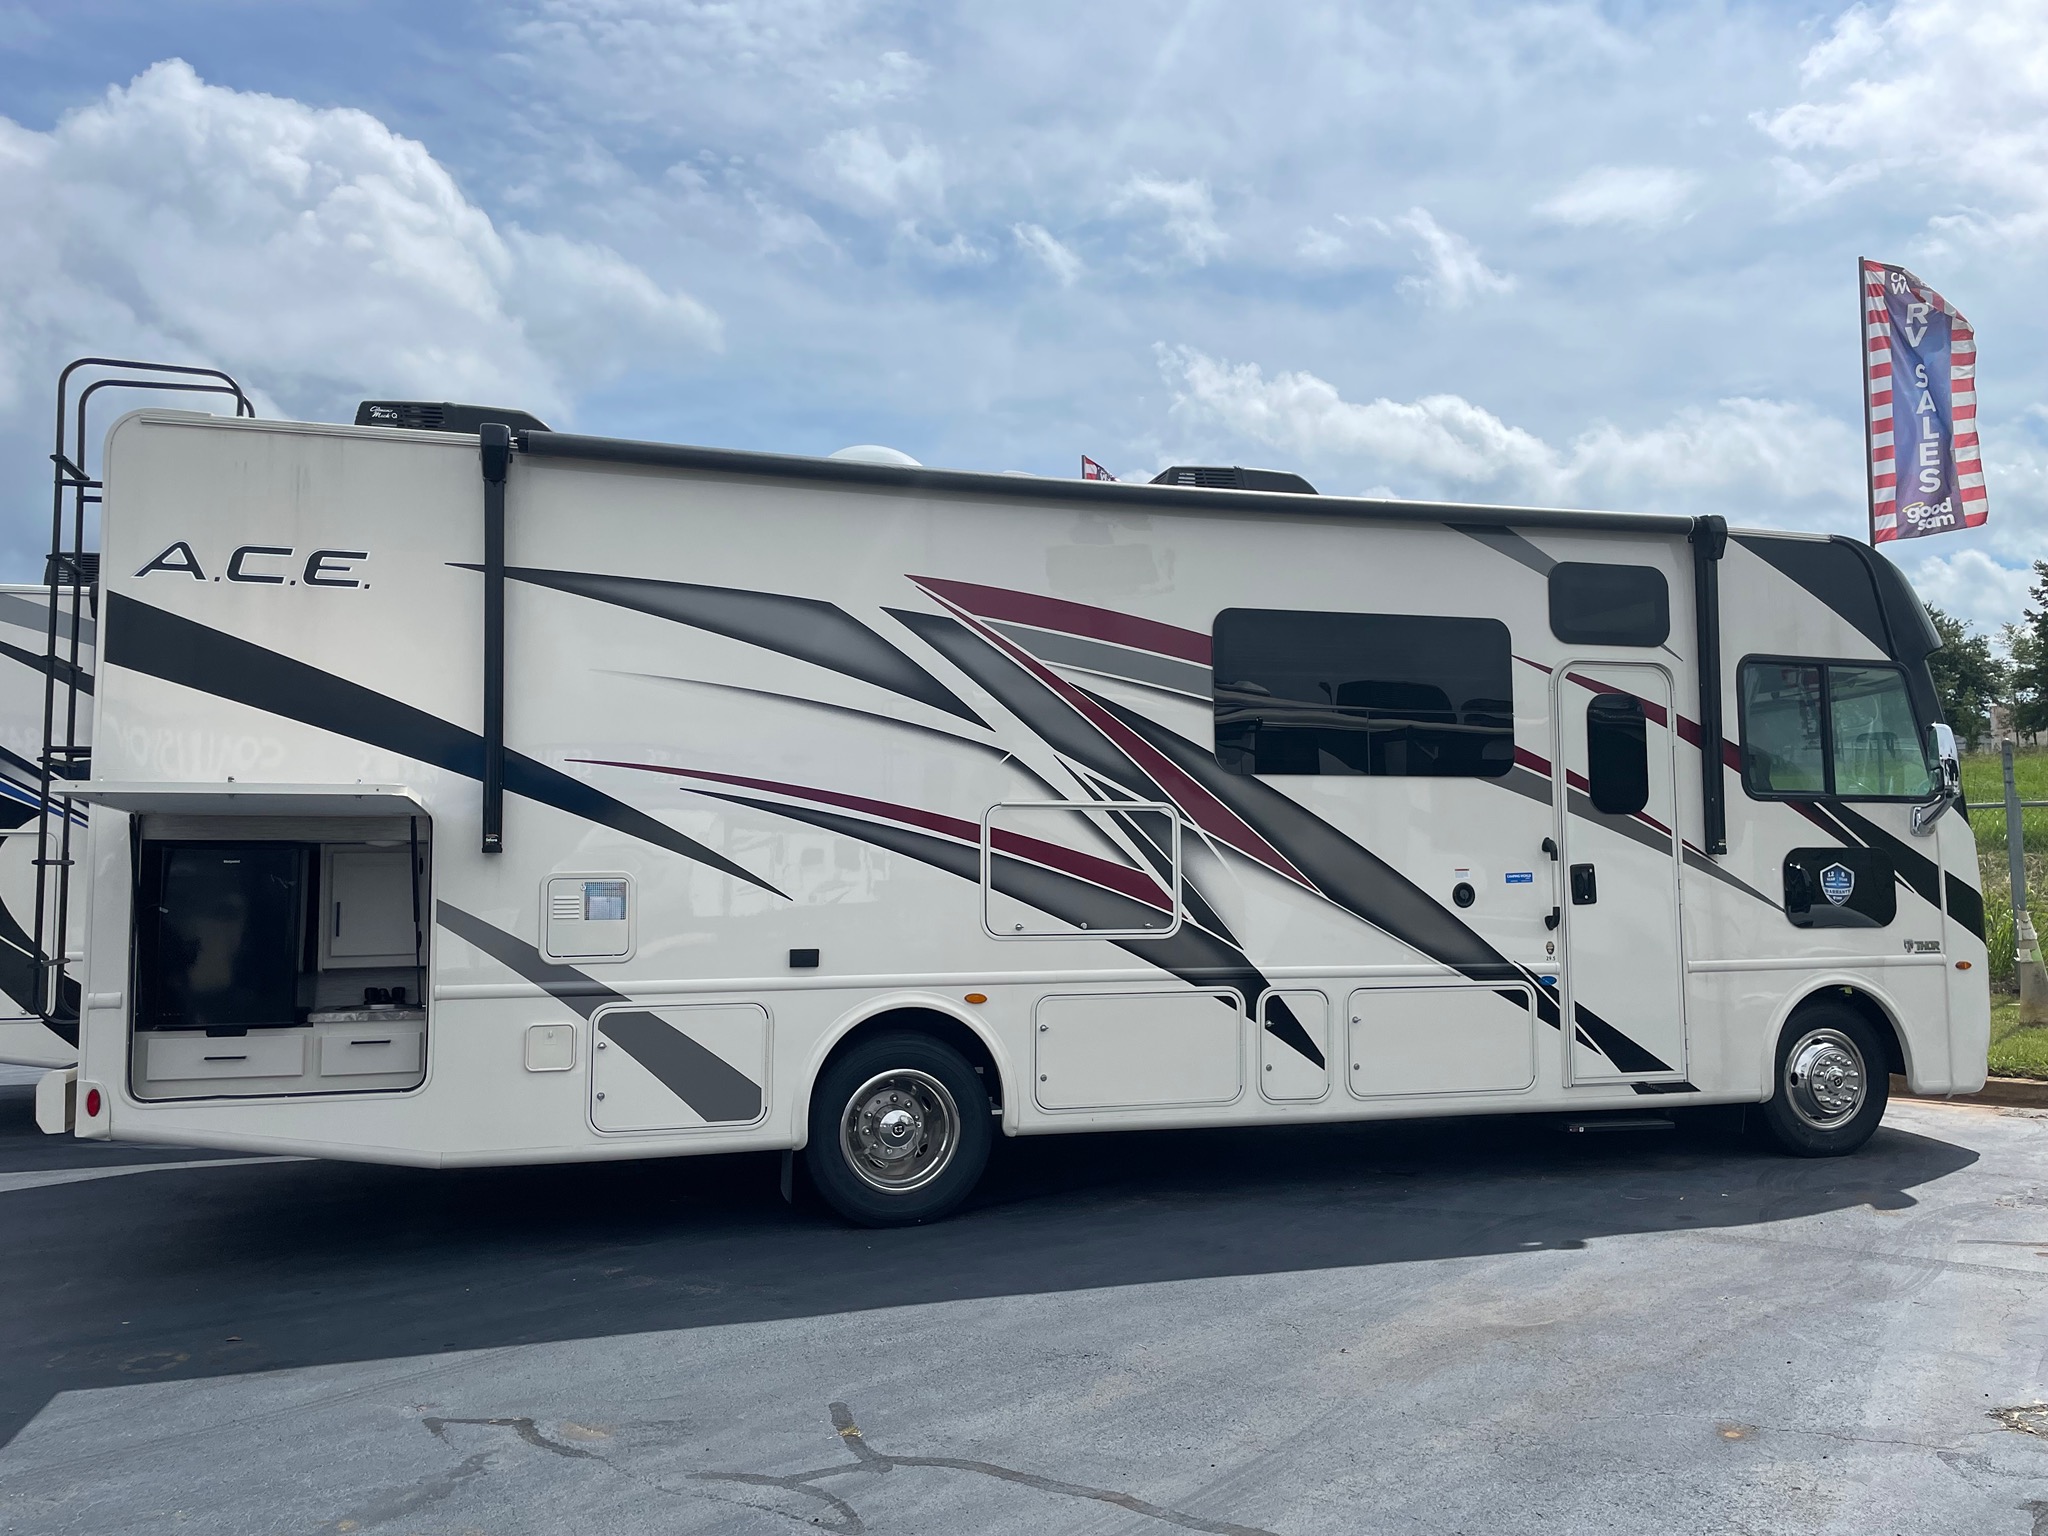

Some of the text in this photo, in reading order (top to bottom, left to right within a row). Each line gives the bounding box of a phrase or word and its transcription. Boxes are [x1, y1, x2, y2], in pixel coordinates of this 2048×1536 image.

[1914, 363, 1942, 493] SALES
[1906, 496, 1953, 524] good
[1917, 513, 1956, 531] sam
[131, 540, 371, 589] A.C.E.
[1914, 941, 1940, 950] THOR
